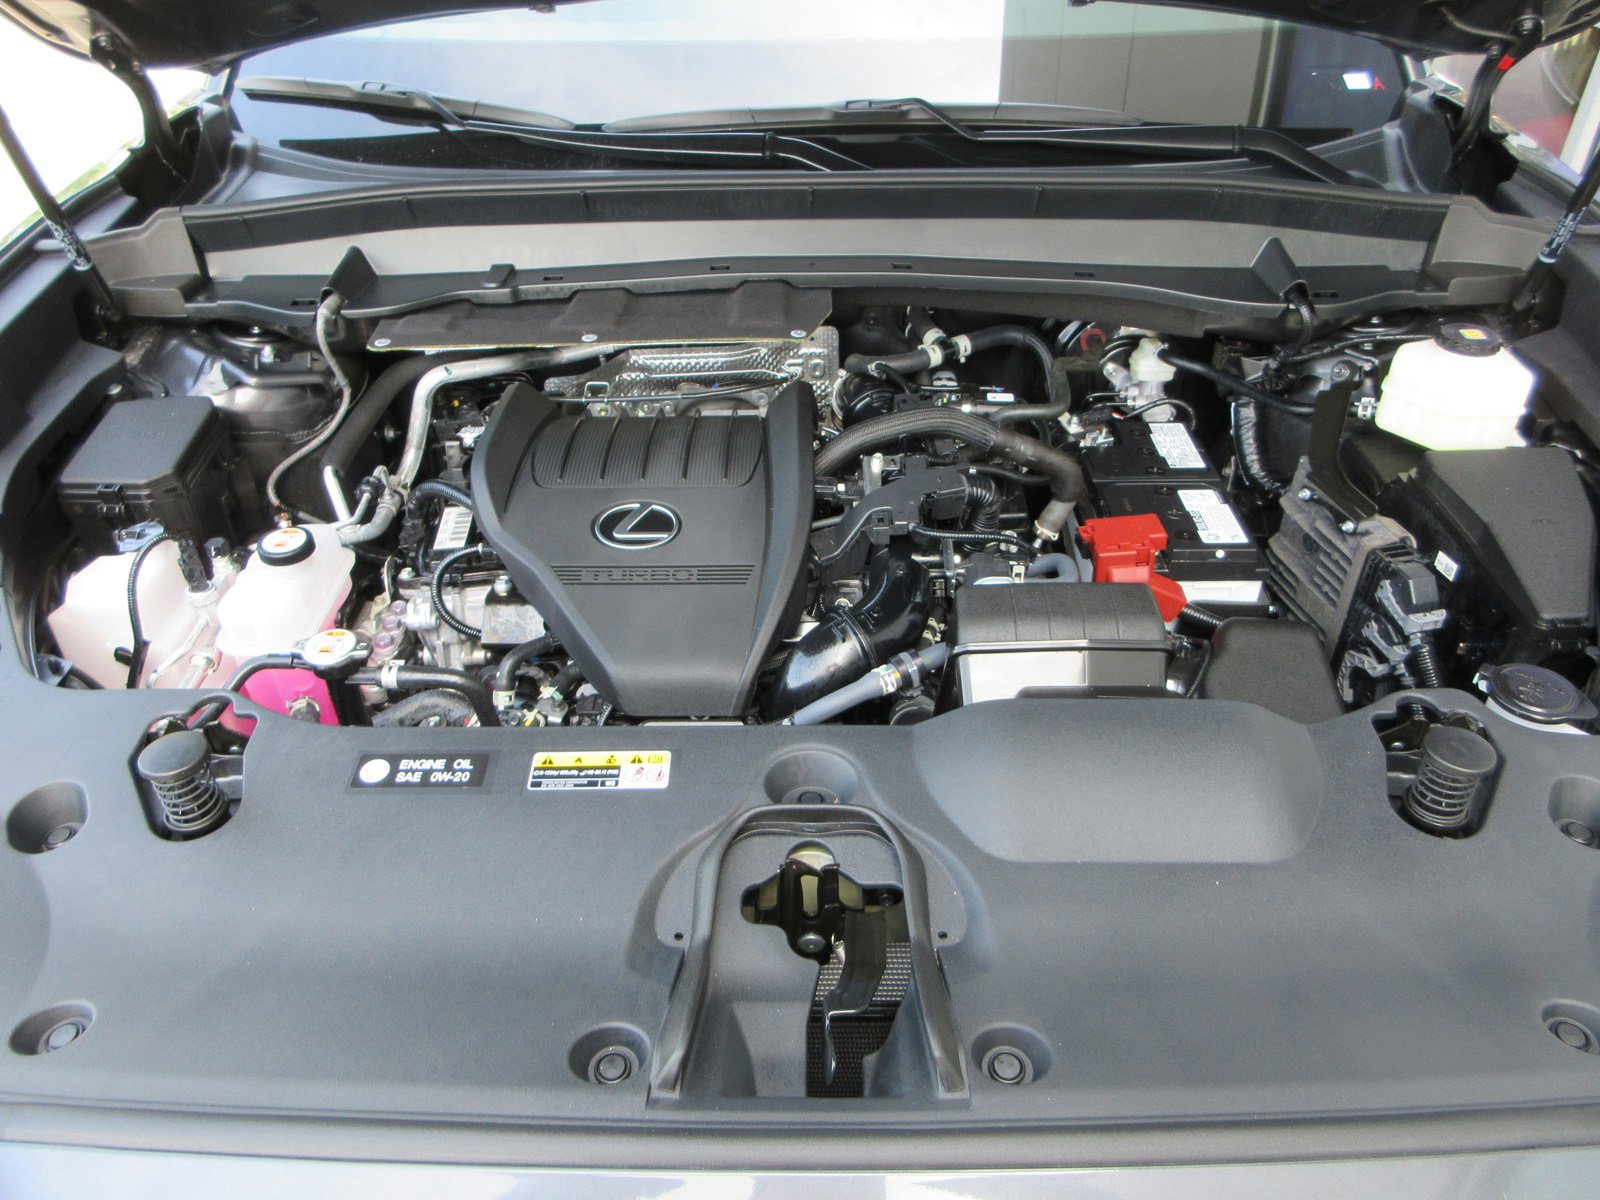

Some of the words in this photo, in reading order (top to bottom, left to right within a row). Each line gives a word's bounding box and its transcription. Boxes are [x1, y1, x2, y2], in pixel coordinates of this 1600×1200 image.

[585, 569, 696, 581] TURBO
[398, 758, 447, 770] ENGINE
[452, 758, 474, 770] OIL
[395, 771, 423, 783] SAE
[429, 771, 471, 783] 0W-20
